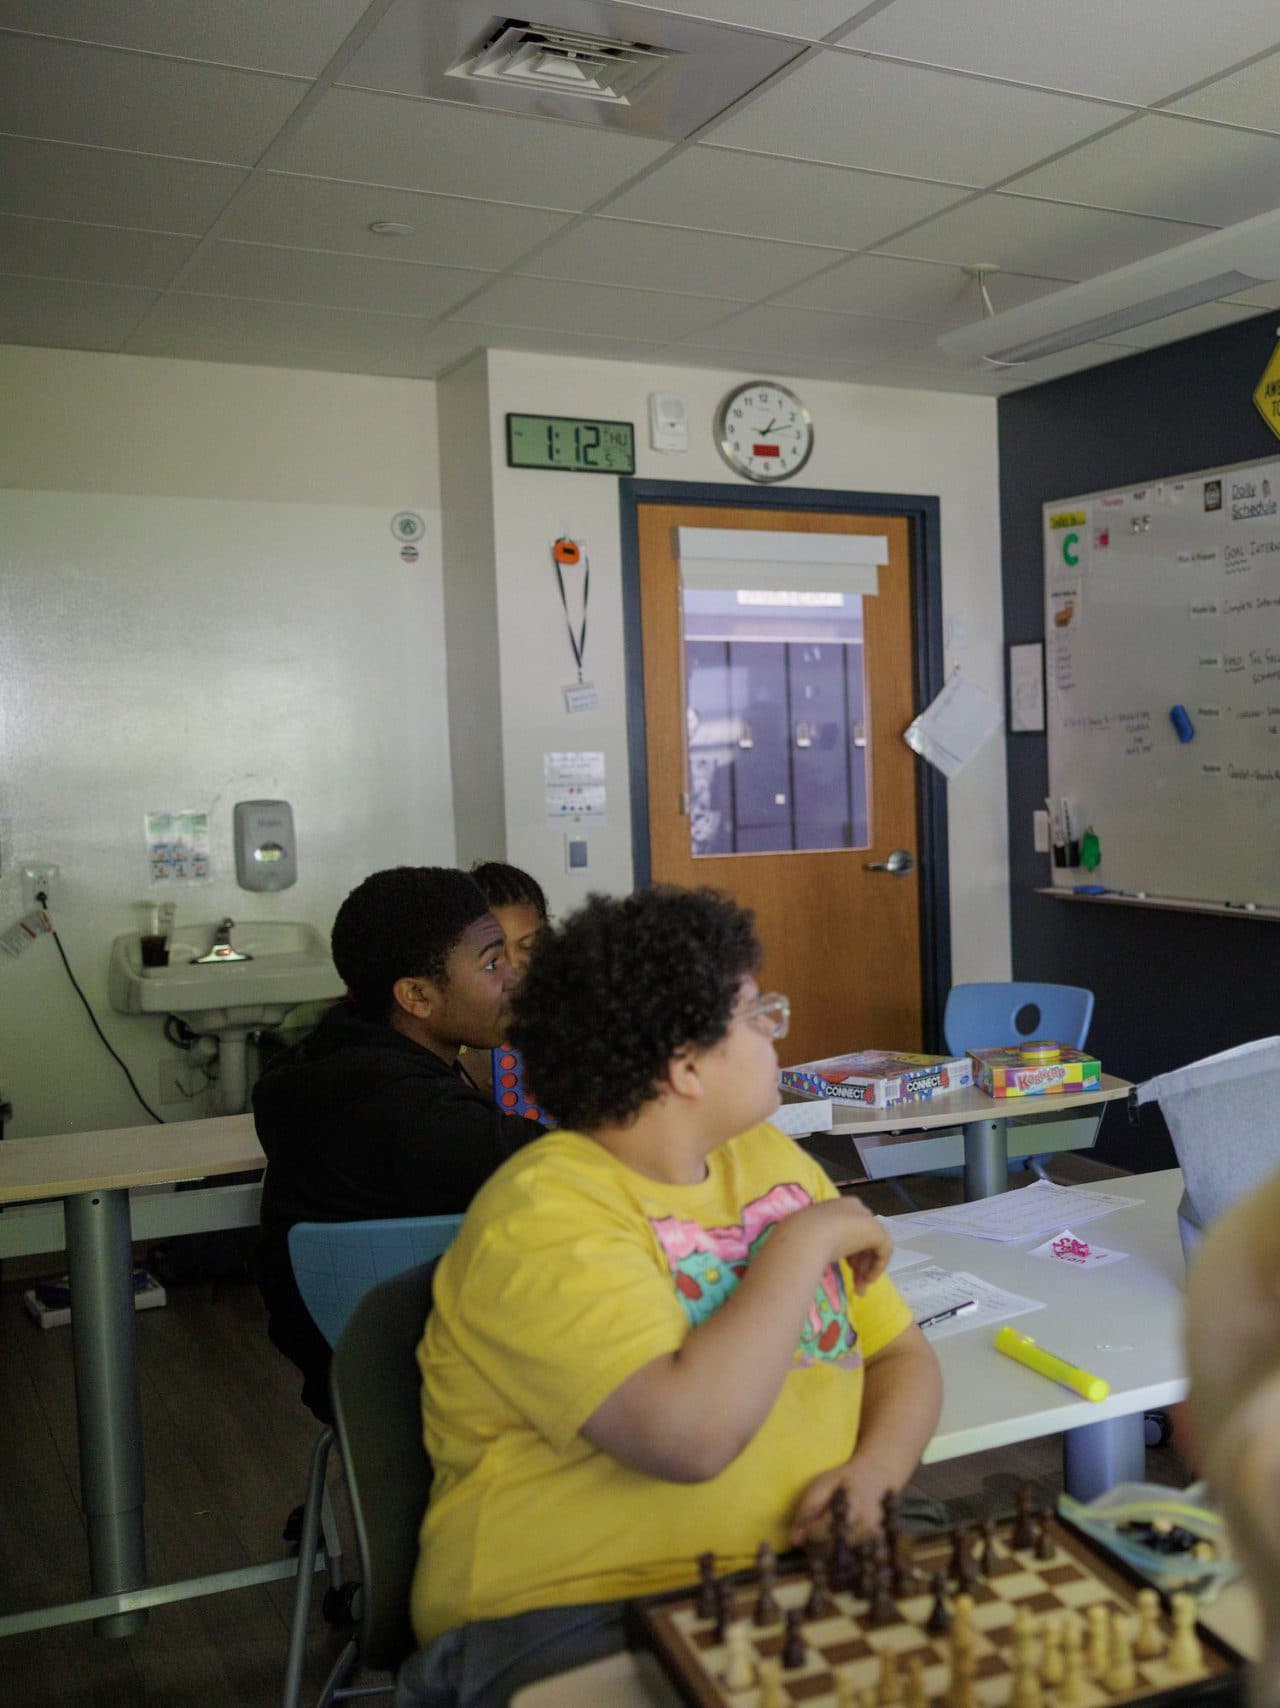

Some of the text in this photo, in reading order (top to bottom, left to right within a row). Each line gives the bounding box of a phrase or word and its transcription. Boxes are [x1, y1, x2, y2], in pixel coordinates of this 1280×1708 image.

[547, 424, 600, 466] 1:12
[906, 1068, 951, 1093] CONNECT 4
[825, 1083, 875, 1105] CONNECT 4
